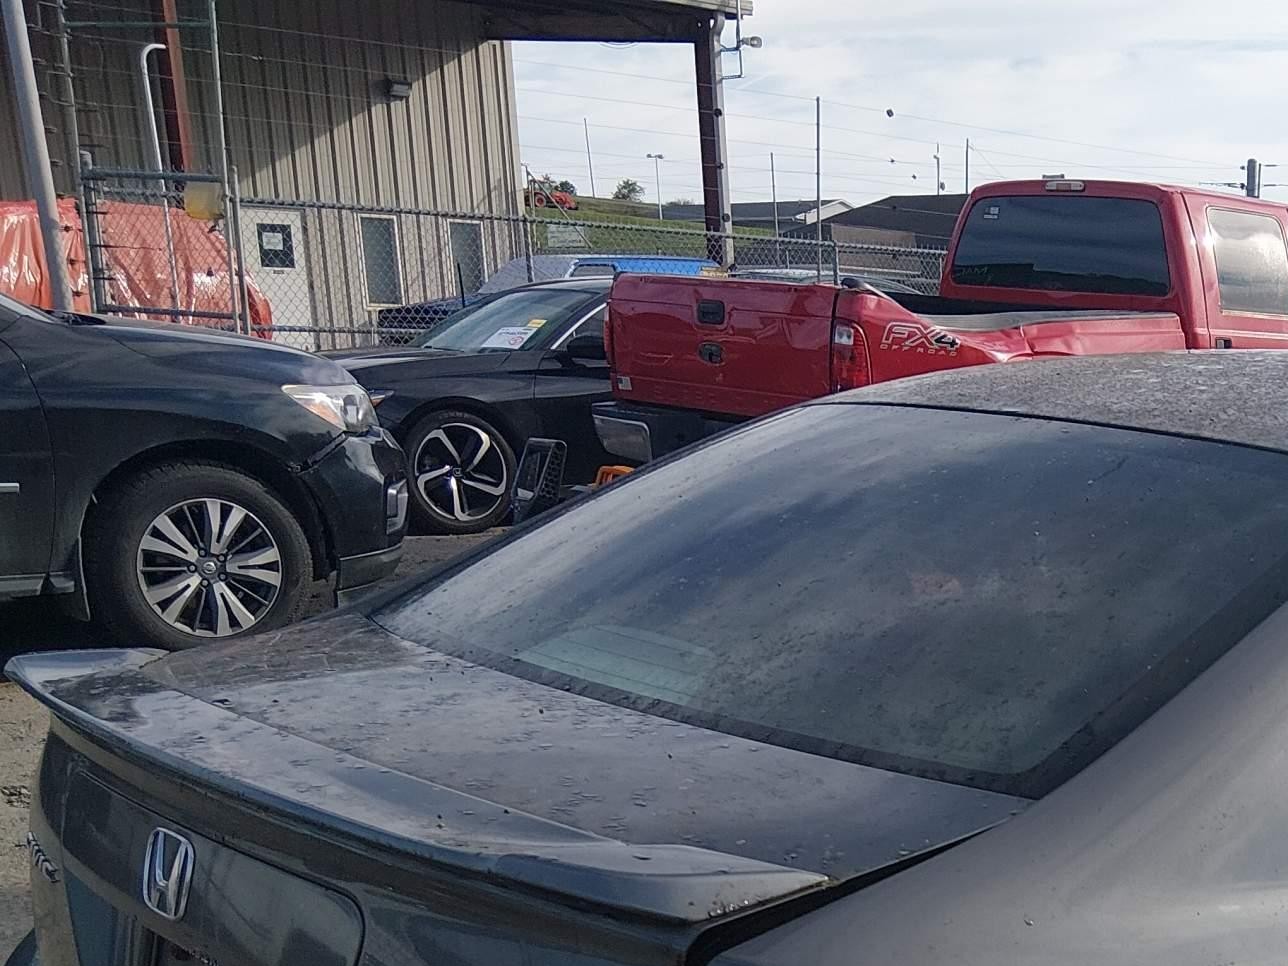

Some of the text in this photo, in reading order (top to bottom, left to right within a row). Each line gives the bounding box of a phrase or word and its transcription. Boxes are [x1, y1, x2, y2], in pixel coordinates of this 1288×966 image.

[882, 321, 961, 352] FX4
[879, 342, 959, 357] OFF ROAD
